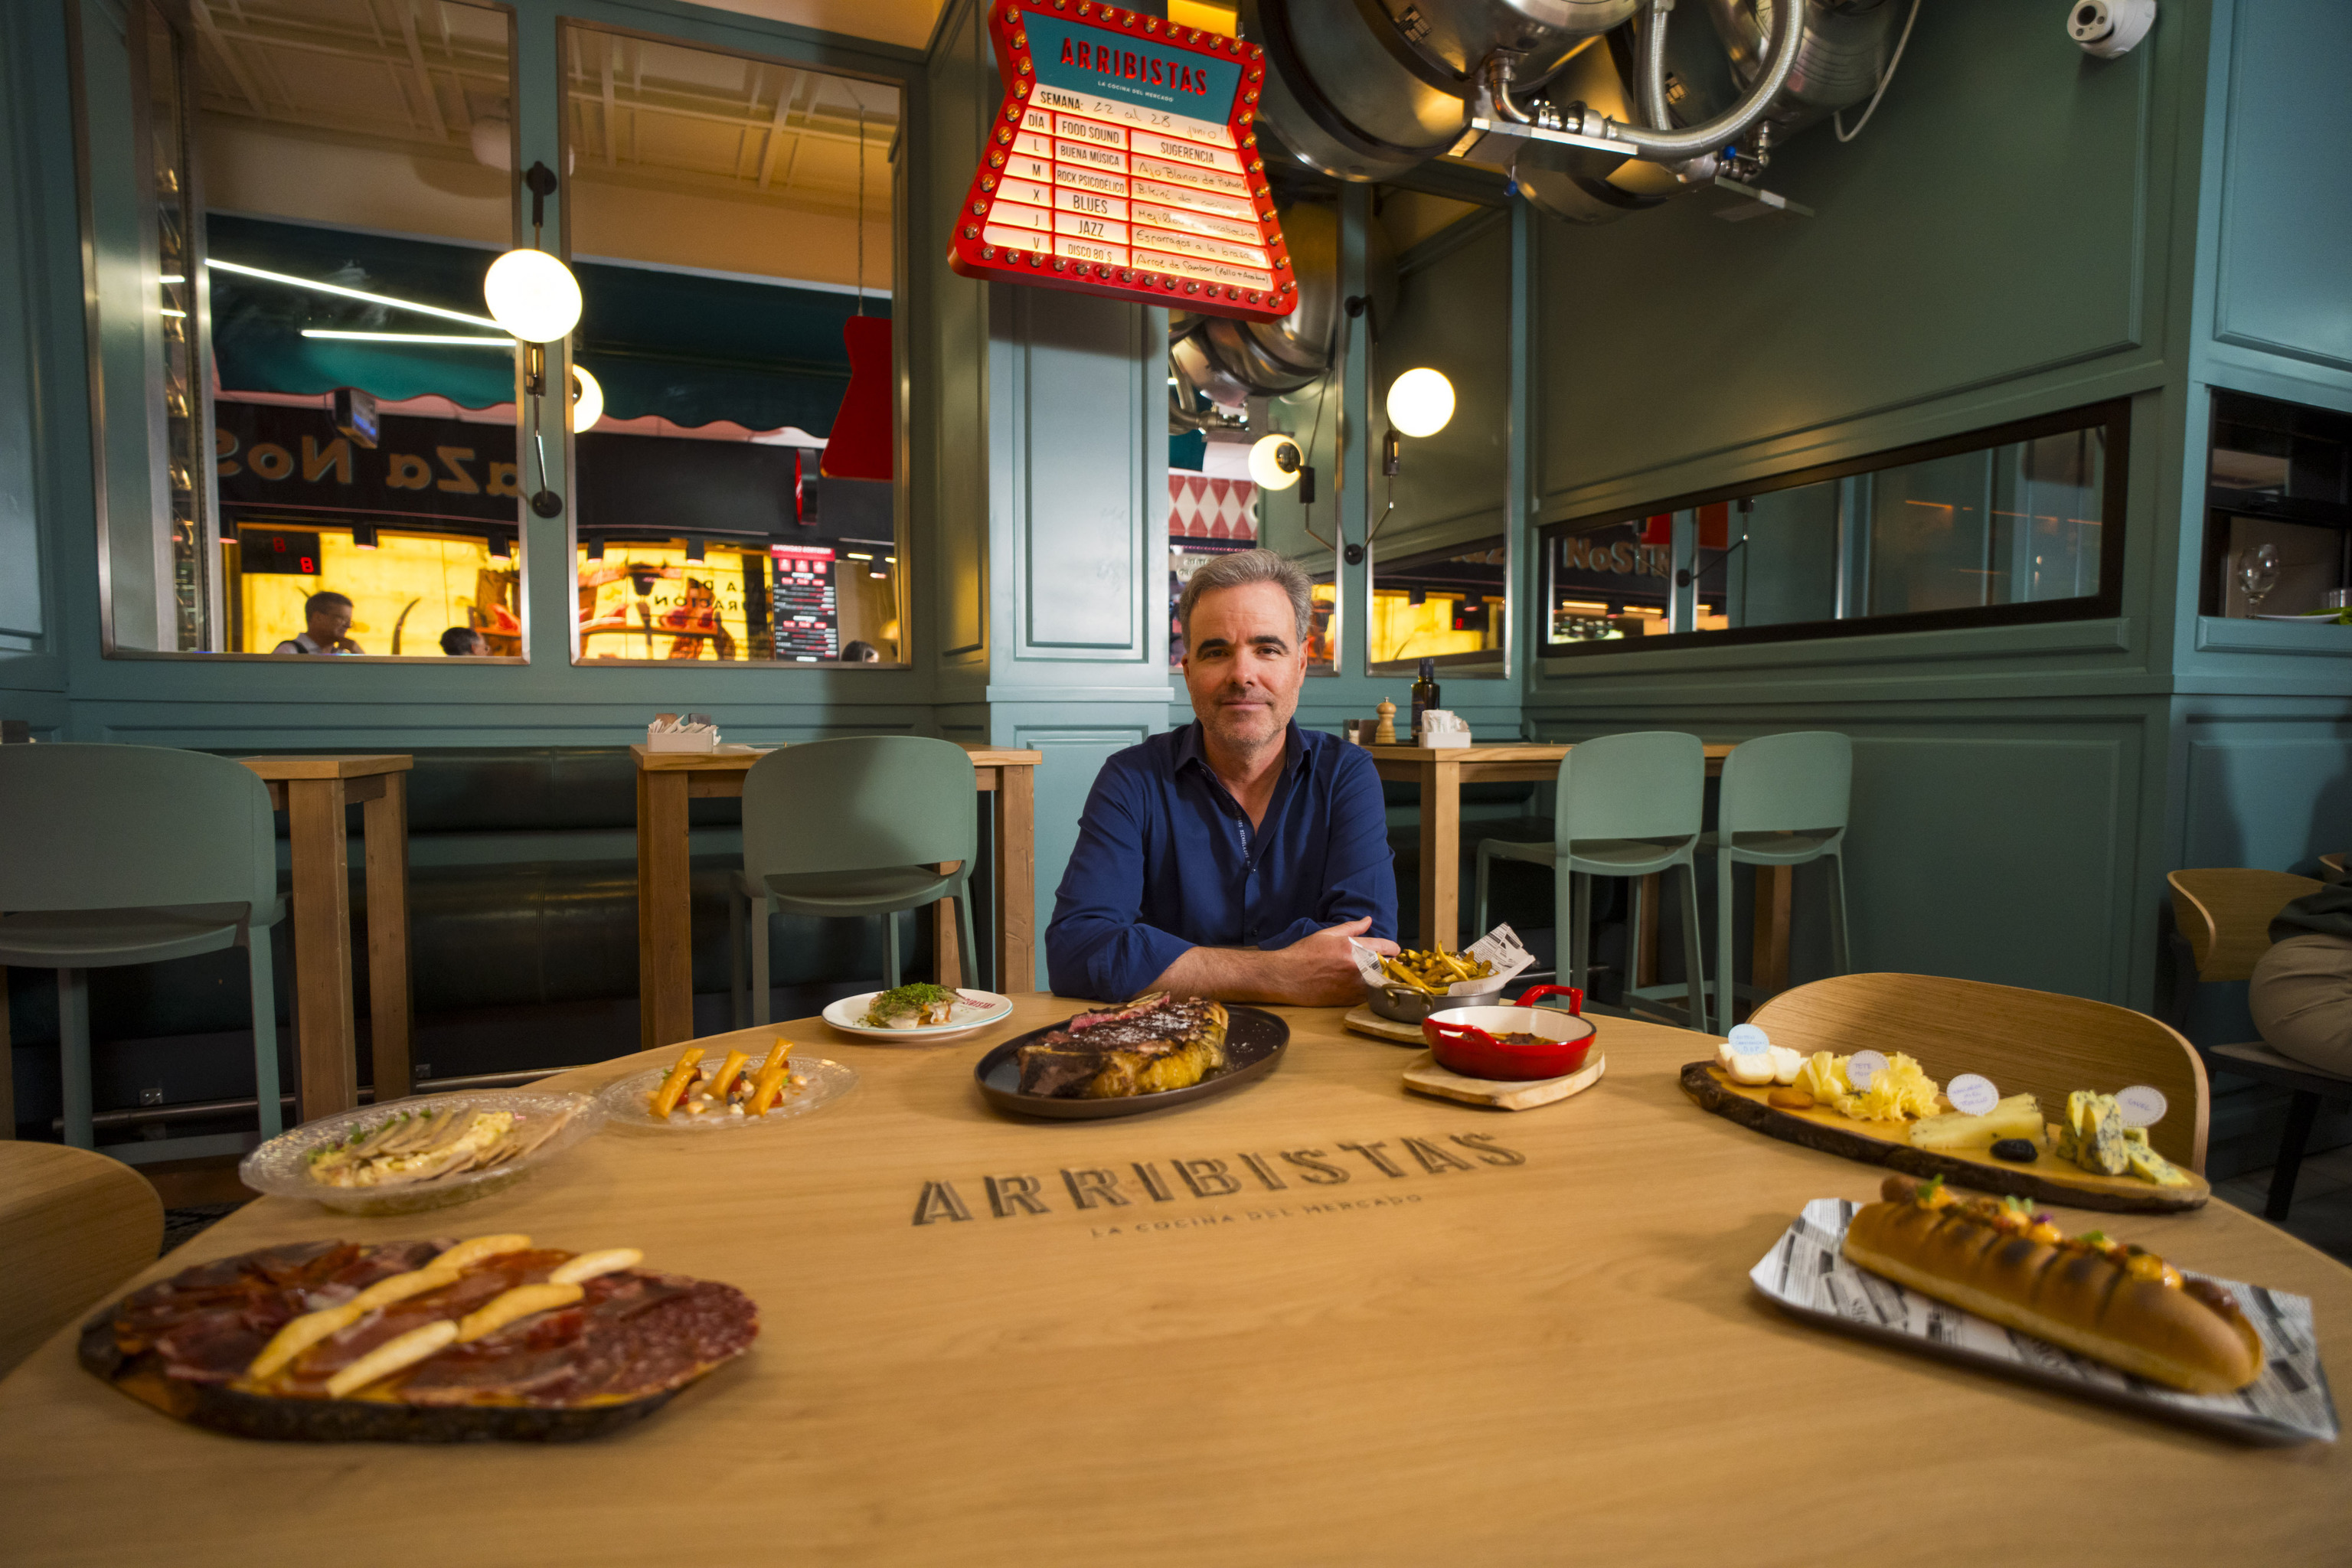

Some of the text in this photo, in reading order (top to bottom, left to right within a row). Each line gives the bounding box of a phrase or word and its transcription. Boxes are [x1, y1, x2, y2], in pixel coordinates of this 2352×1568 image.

[1061, 38, 1207, 96] ARRIBISTAS
[1107, 83, 1130, 93] COCINA
[1145, 91, 1174, 103] MERCADO
[1040, 91, 1084, 112] SEMANA:
[1093, 102, 1113, 114] 22
[1125, 108, 1142, 122] al
[1151, 114, 1171, 128] 28
[1028, 113, 1044, 129] DÍA
[1062, 121, 1119, 144] FOOD SOUND
[1034, 139, 1040, 152] L
[1161, 142, 1214, 165] SUGERENCIA
[1060, 145, 1119, 167] BUENA MÚSICA
[1032, 164, 1040, 177] M
[1202, 173, 1214, 185] de
[1057, 170, 1125, 194] ROCK PSICODÉLICO
[1034, 189, 1040, 201] X
[1073, 194, 1108, 214] BLUES
[1034, 214, 1039, 227] J
[1078, 220, 1104, 238] JAZZ
[1034, 237, 1040, 250] V
[1068, 243, 1092, 258] DISCO
[1207, 243, 1216, 253] la
[1169, 259, 1180, 269] de
[912, 1131, 1526, 1226] ARRIBISTAS
[1090, 1193, 1422, 1238] LA COCINA DEL MERCADO
